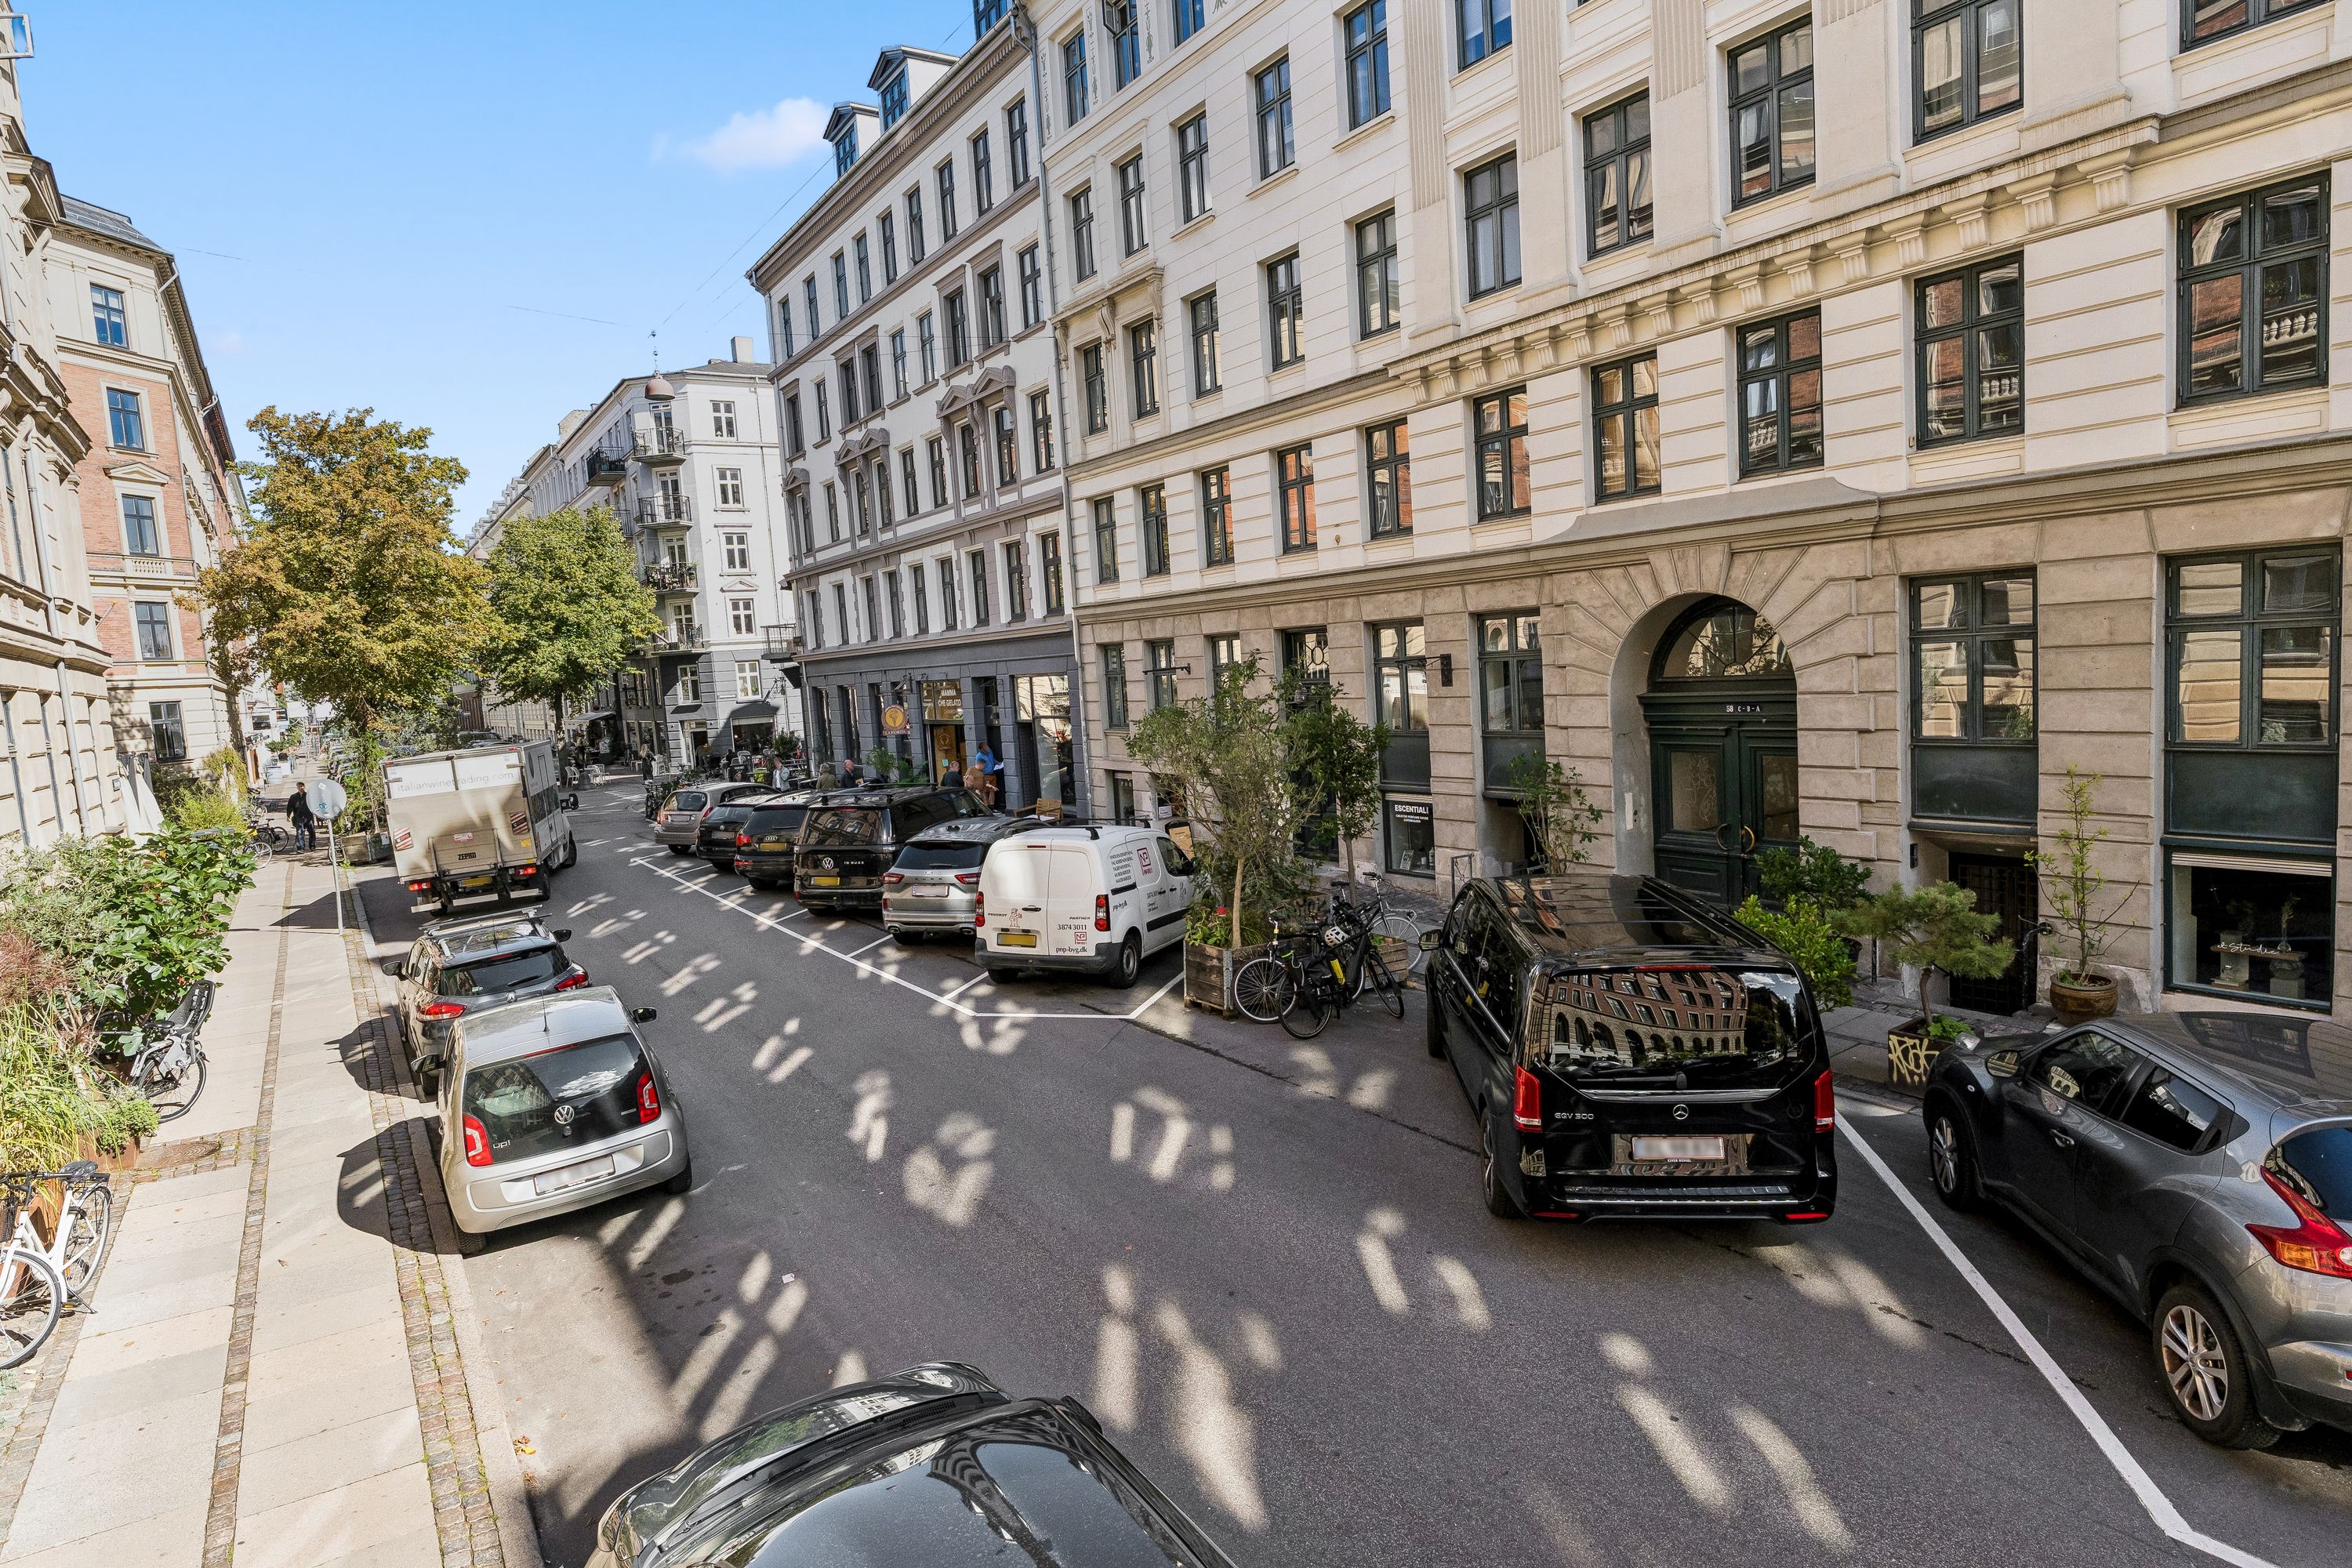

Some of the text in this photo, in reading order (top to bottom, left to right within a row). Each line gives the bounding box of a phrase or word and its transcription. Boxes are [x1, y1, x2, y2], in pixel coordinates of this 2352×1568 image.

[458, 851, 477, 861] ZEPRO
[1055, 946, 1087, 954] pnp-byg.dk
[492, 1139, 510, 1149] up!
